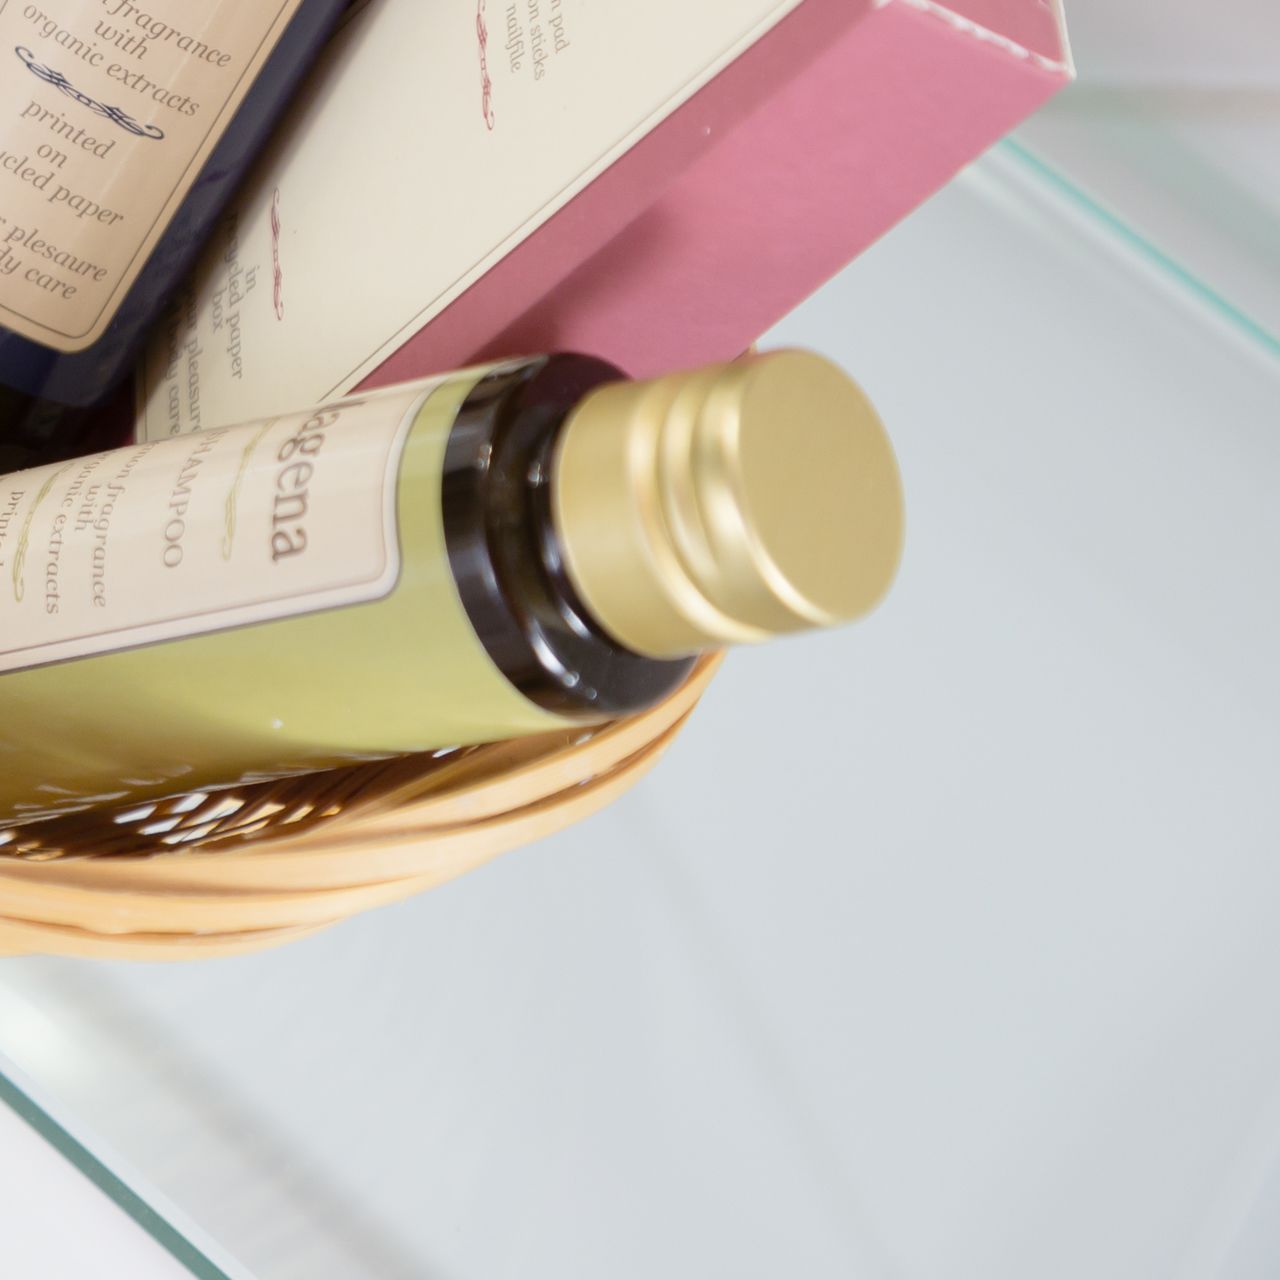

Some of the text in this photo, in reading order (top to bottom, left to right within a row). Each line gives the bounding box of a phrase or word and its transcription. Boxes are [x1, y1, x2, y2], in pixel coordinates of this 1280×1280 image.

[94, 20, 148, 60] with
[505, 3, 525, 73] nailfile
[530, 24, 549, 81] sticks
[548, 12, 571, 54] pad
[23, 4, 200, 117] organic extracts
[19, 98, 116, 162] printed
[36, 143, 68, 169] on
[47, 183, 124, 226] paper
[4, 224, 108, 283] plesaure
[24, 267, 77, 300] care
[245, 266, 260, 293] in
[211, 288, 227, 334] box
[224, 235, 244, 381] cycled paper
[168, 385, 181, 435] care
[74, 484, 103, 532] with
[46, 513, 67, 615] extracts
[92, 482, 125, 608] fragrance
